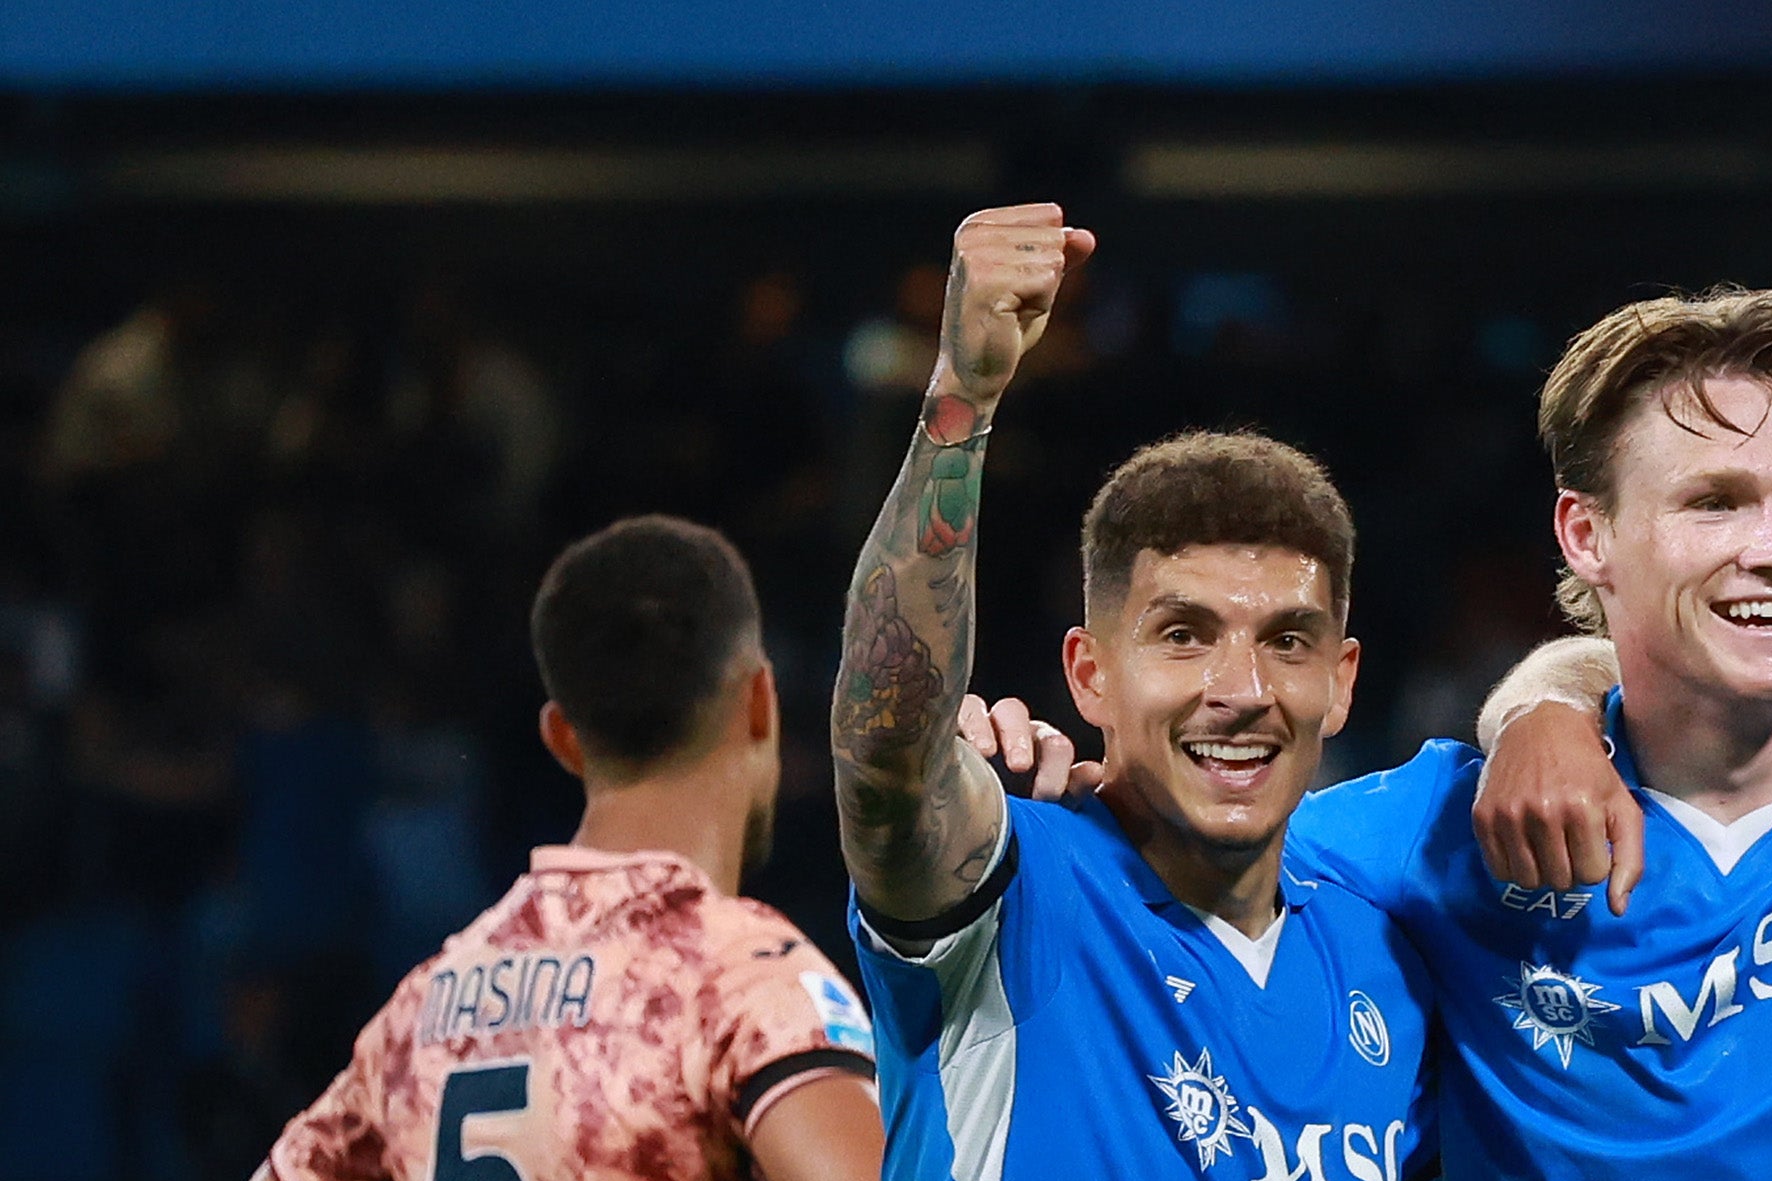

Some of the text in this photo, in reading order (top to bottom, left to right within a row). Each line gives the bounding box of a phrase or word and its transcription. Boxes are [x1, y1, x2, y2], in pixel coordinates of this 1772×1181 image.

[1502, 883, 1593, 919] EA7
[420, 954, 595, 1043] MASINA
[1354, 1011, 1380, 1046] N
